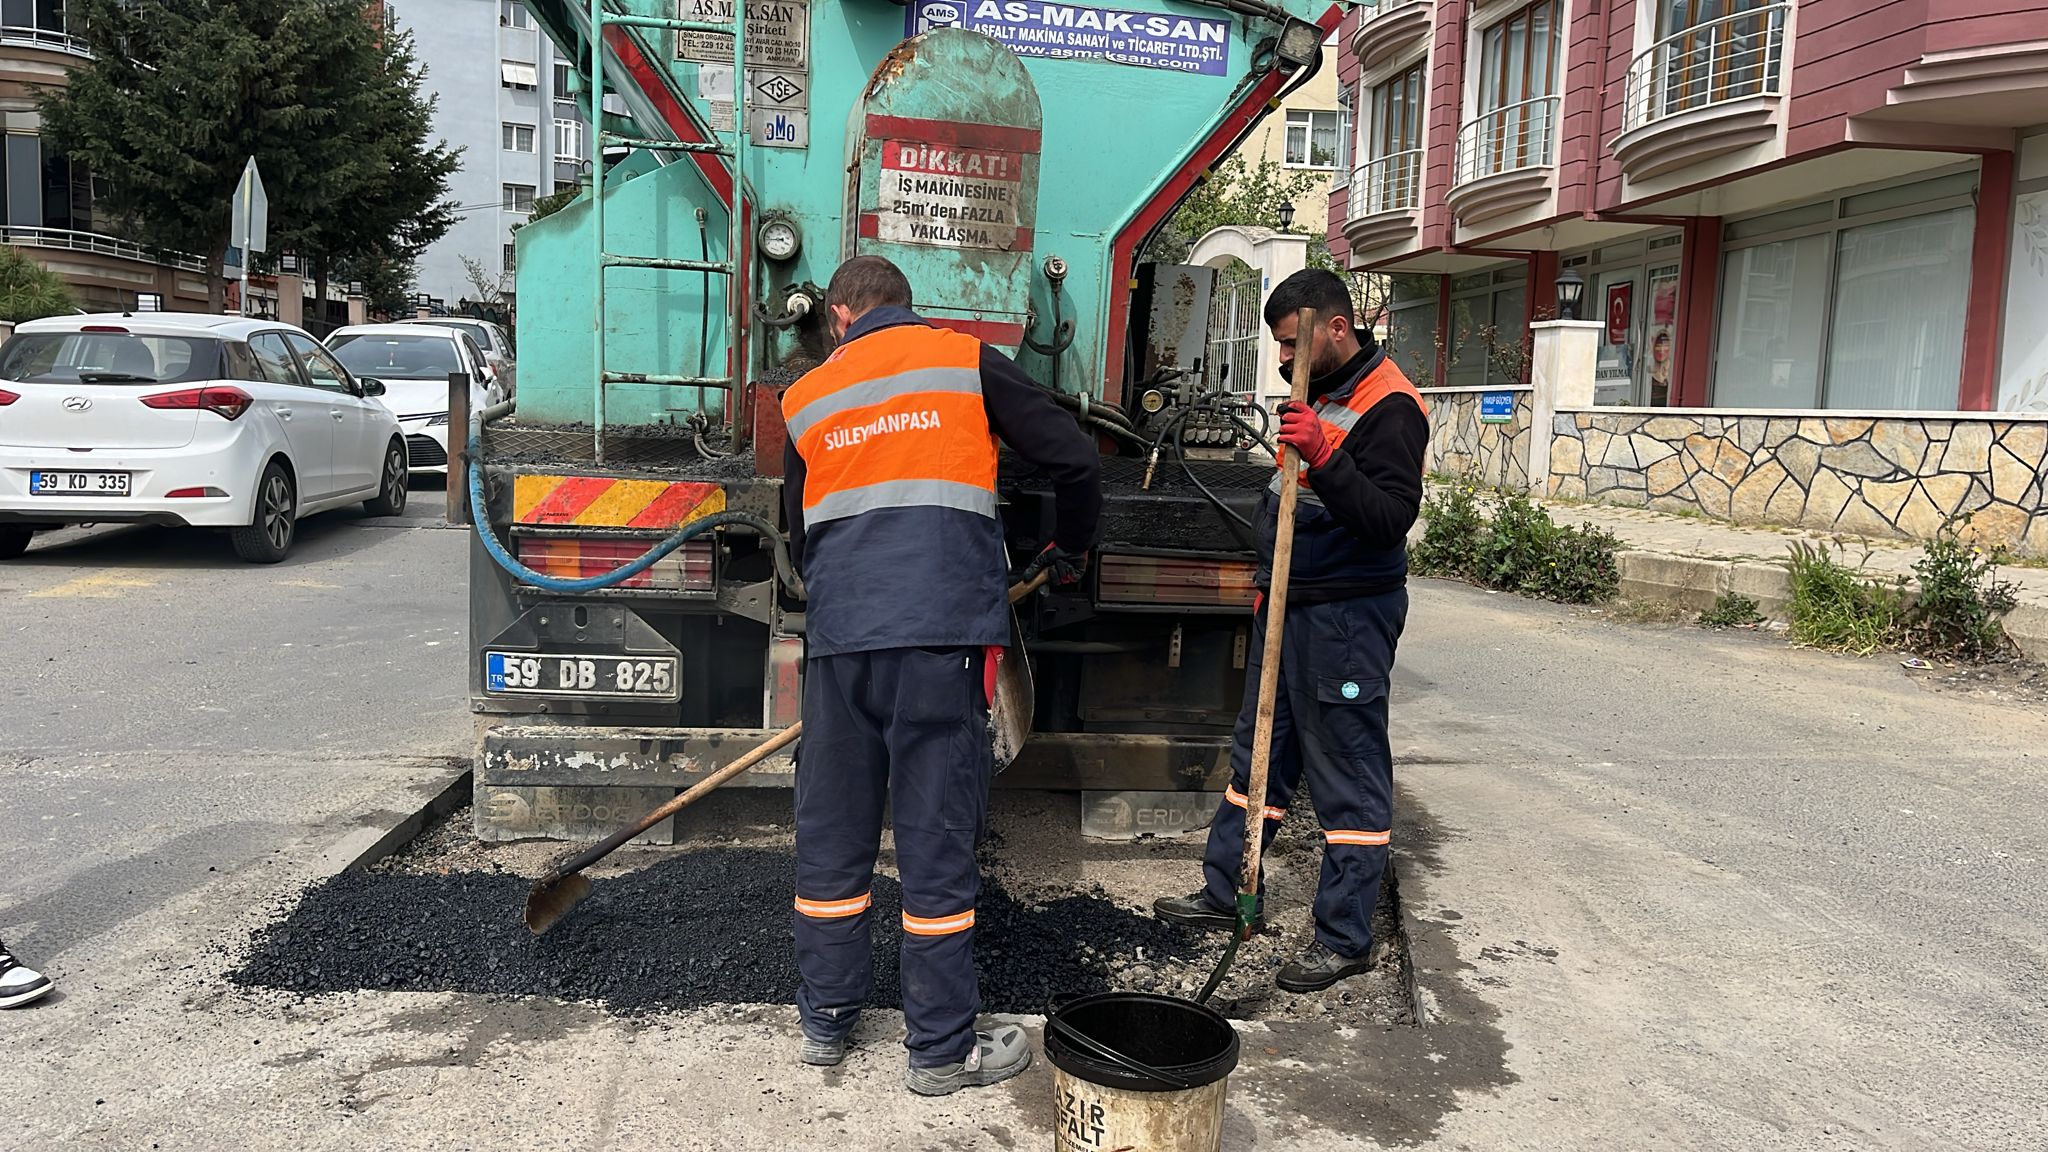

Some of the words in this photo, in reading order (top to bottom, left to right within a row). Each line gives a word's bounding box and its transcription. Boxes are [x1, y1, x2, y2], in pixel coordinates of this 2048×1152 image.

[692, 0, 794, 23] AS.MK.SAN
[926, 8, 955, 18] AMS
[973, 0, 1225, 44] AS-MAK-SAN
[747, 23, 787, 36] Şirketi
[973, 23, 1016, 39] ASFALT
[1018, 26, 1065, 45] MAKİNA
[1067, 32, 1110, 49] SANAYİ
[1112, 40, 1125, 50] ve
[1128, 36, 1177, 56] TİCARET
[769, 81, 790, 98] TSE
[766, 114, 795, 142] DMO
[899, 144, 1008, 177] DİKKAT!
[898, 174, 912, 195] İŞ
[915, 178, 1007, 201] MAKİNESİNE
[960, 208, 1004, 223] FAZLA
[39, 474, 58, 488] 59
[68, 474, 88, 489] KD
[98, 474, 127, 489] 335
[491, 674, 503, 683] TR
[504, 658, 539, 688] 59
[559, 660, 596, 689] DB
[616, 661, 671, 692] 825
